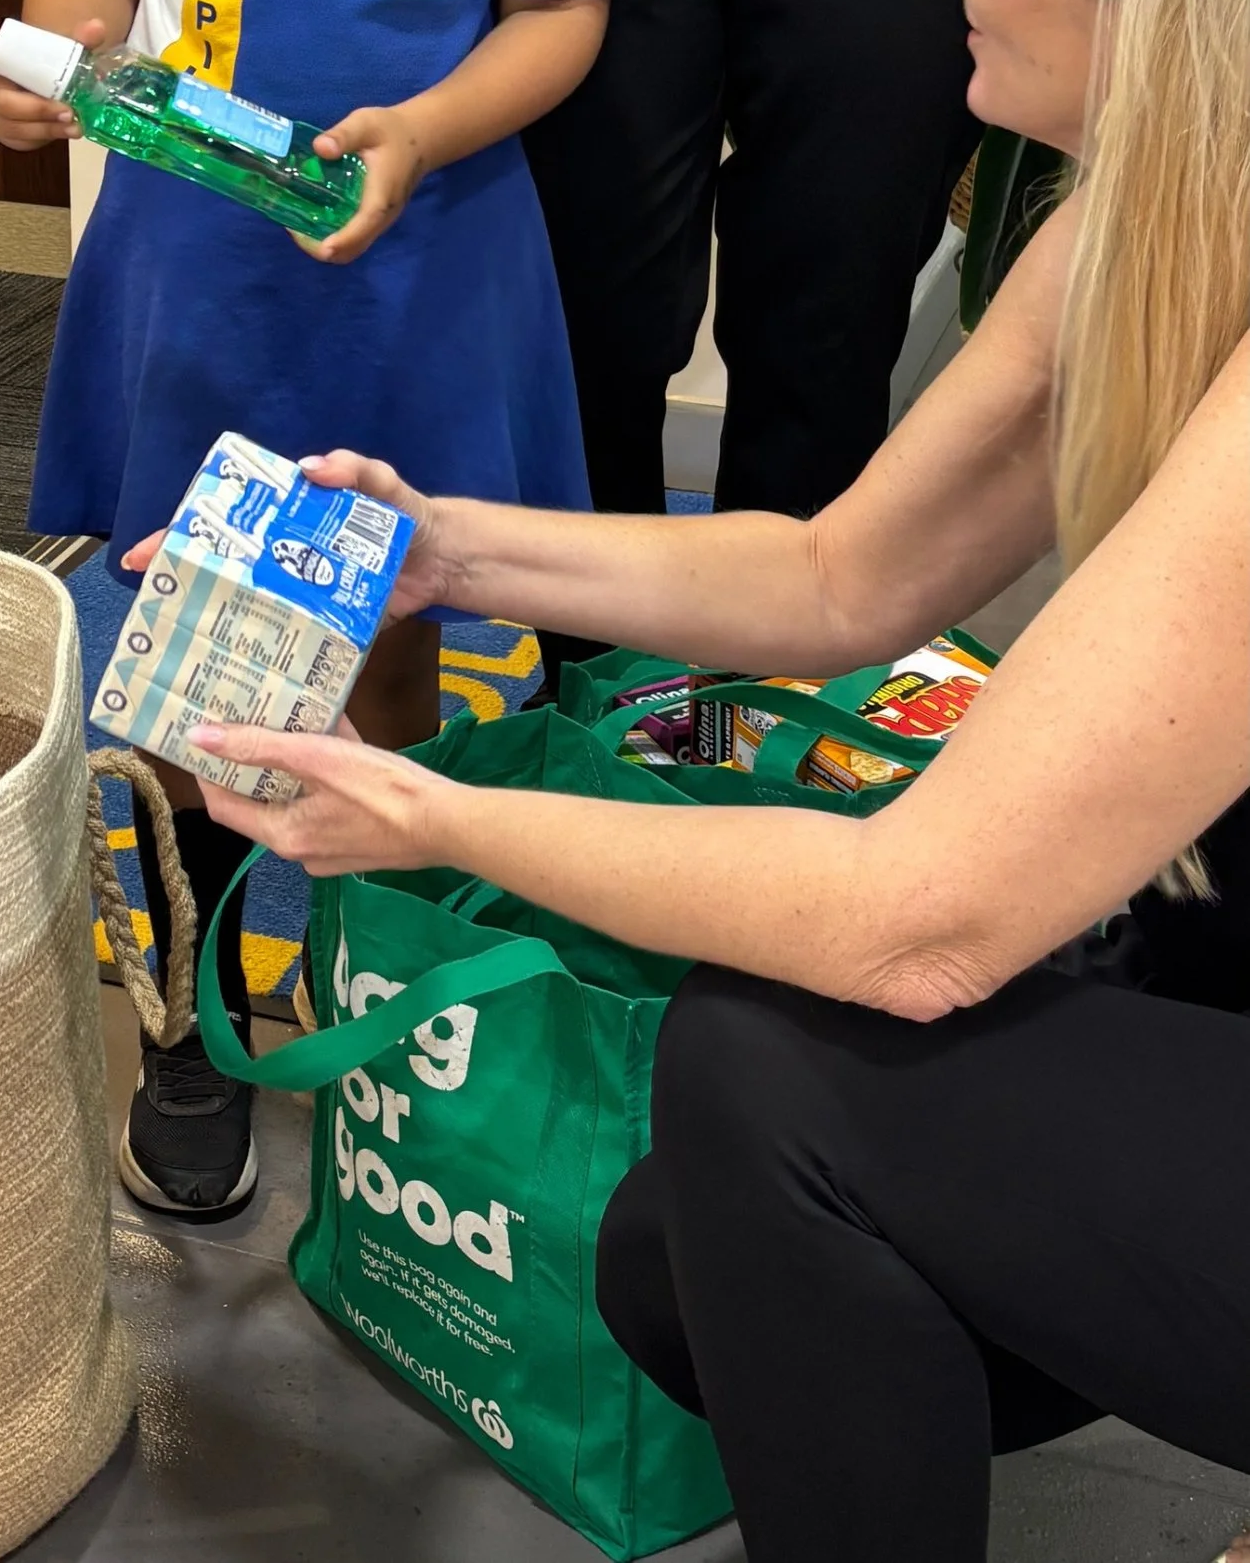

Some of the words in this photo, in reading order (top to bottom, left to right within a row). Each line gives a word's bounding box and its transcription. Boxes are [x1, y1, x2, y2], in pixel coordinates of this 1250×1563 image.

[334, 1066, 411, 1144] or
[358, 1228, 381, 1253] Use
[383, 1246, 407, 1267] this
[409, 1258, 436, 1285] bag
[438, 1278, 472, 1309] again
[473, 1303, 498, 1326] and
[359, 1249, 399, 1277] again.
[400, 1269, 410, 1283] If
[412, 1276, 422, 1290] it
[423, 1285, 448, 1310] gets
[361, 1265, 391, 1287] we'll
[392, 1281, 436, 1318] replace
[436, 1309, 445, 1327] it
[446, 1318, 461, 1338] for
[463, 1332, 494, 1357] free.
